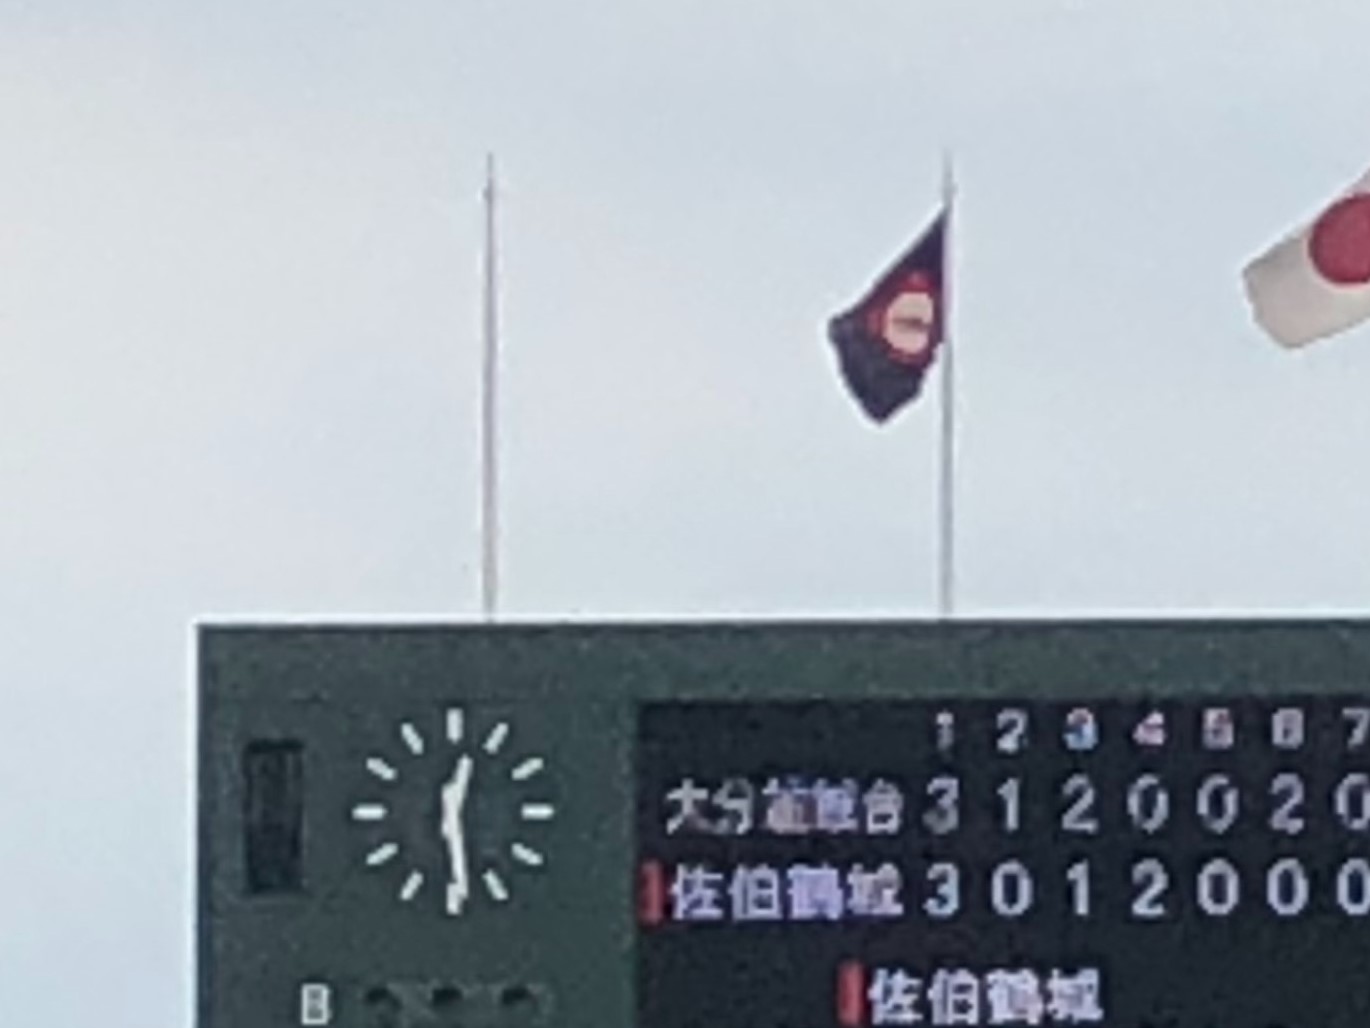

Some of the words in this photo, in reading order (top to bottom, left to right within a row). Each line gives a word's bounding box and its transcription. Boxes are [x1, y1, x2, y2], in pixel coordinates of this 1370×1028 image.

[935, 711, 954, 749] 1
[997, 709, 1027, 753] 2
[1064, 708, 1098, 750] 3
[1133, 711, 1165, 746] 4
[924, 776, 959, 834] 3
[997, 778, 1019, 831] 1
[1062, 774, 1098, 833] 2
[1127, 774, 1169, 833] 0
[1197, 774, 1238, 833] 0
[1270, 773, 1304, 835] 2
[923, 862, 959, 917] 3
[991, 861, 1032, 916] 0
[1067, 862, 1089, 916] 1
[1131, 859, 1168, 917] 2
[1197, 858, 1239, 915] 0
[1267, 858, 1309, 916] 0
[301, 983, 331, 1026] B
